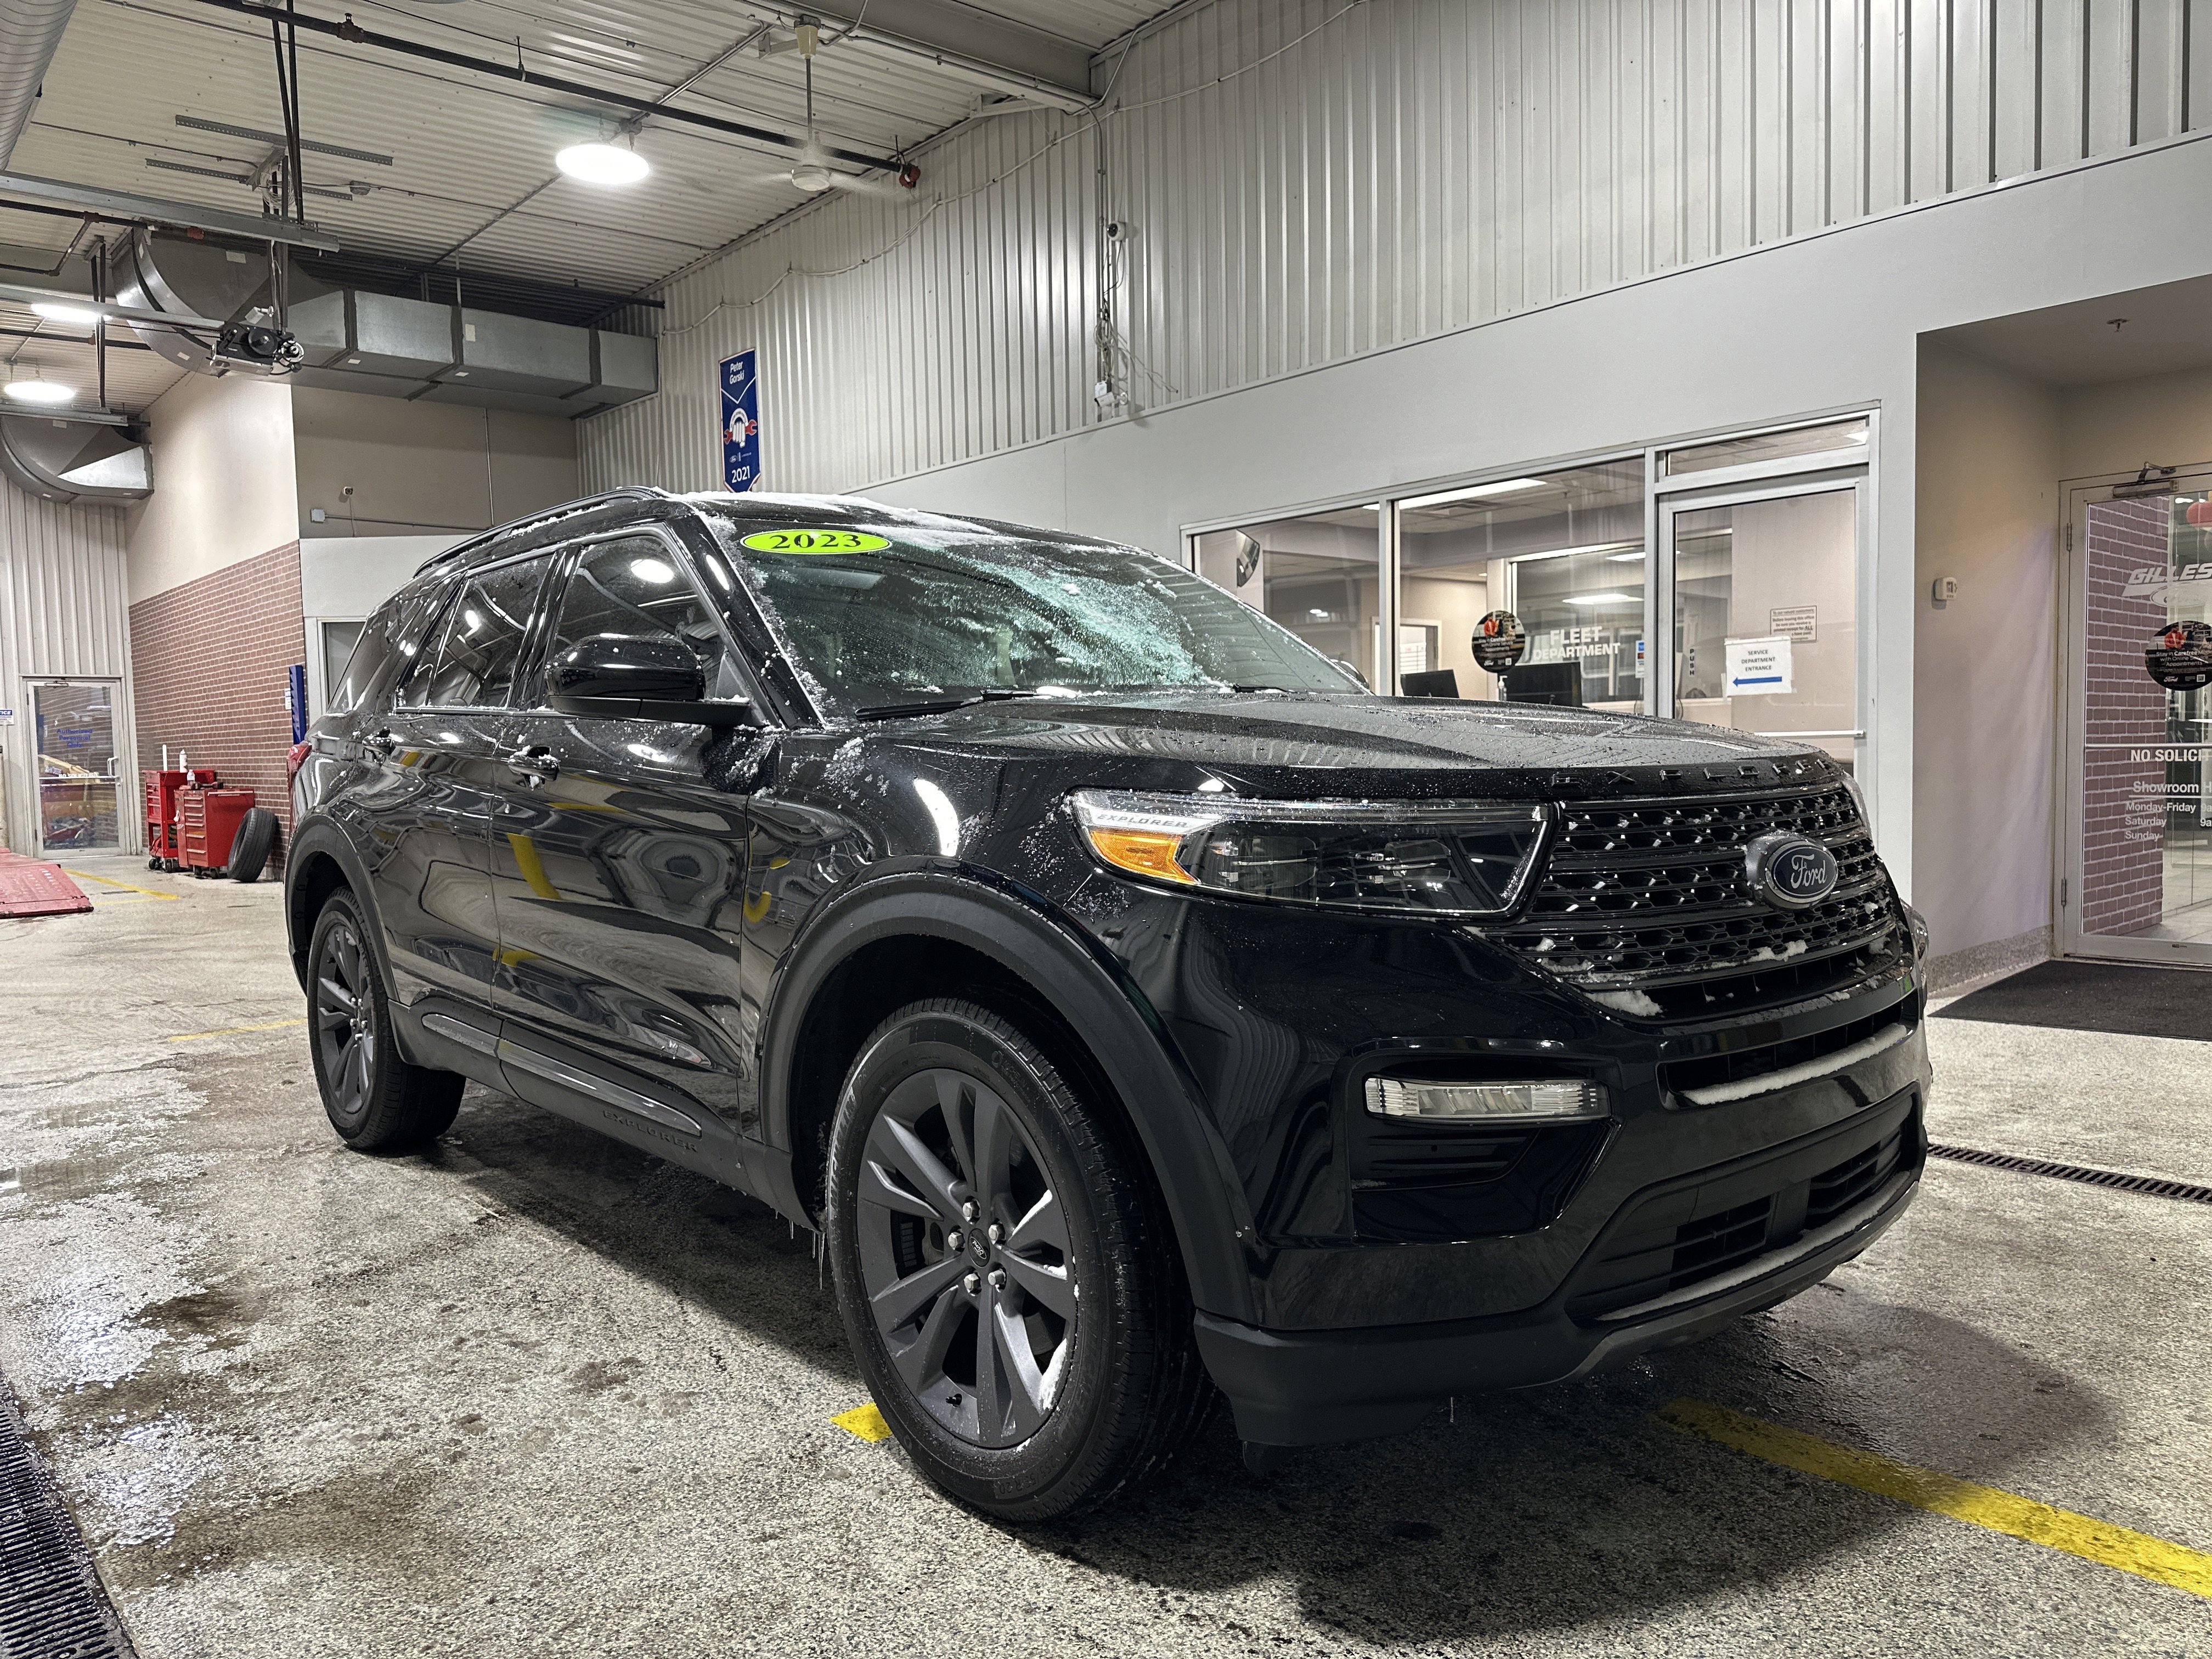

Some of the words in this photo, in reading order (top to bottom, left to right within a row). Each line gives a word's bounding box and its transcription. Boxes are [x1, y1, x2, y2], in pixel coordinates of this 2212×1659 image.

[730, 362, 743, 374] Peter
[730, 369, 744, 384] Gorski
[731, 465, 751, 483] 2021
[769, 533, 861, 550] 2023
[1550, 625, 1602, 645] FLEET
[1532, 642, 1621, 661] DEPARTMENT
[2131, 749, 2151, 762] NO
[1551, 758, 1831, 787] EXPLORER
[2133, 781, 2199, 793] Showroom
[2126, 802, 2197, 814] Monday-Friday
[1097, 814, 1188, 827] EXPLORER
[2125, 816, 2167, 828] Saturday
[2125, 830, 2160, 842] Sunday
[1791, 854, 1828, 889] Ford
[603, 1109, 698, 1153] EXPLORER
